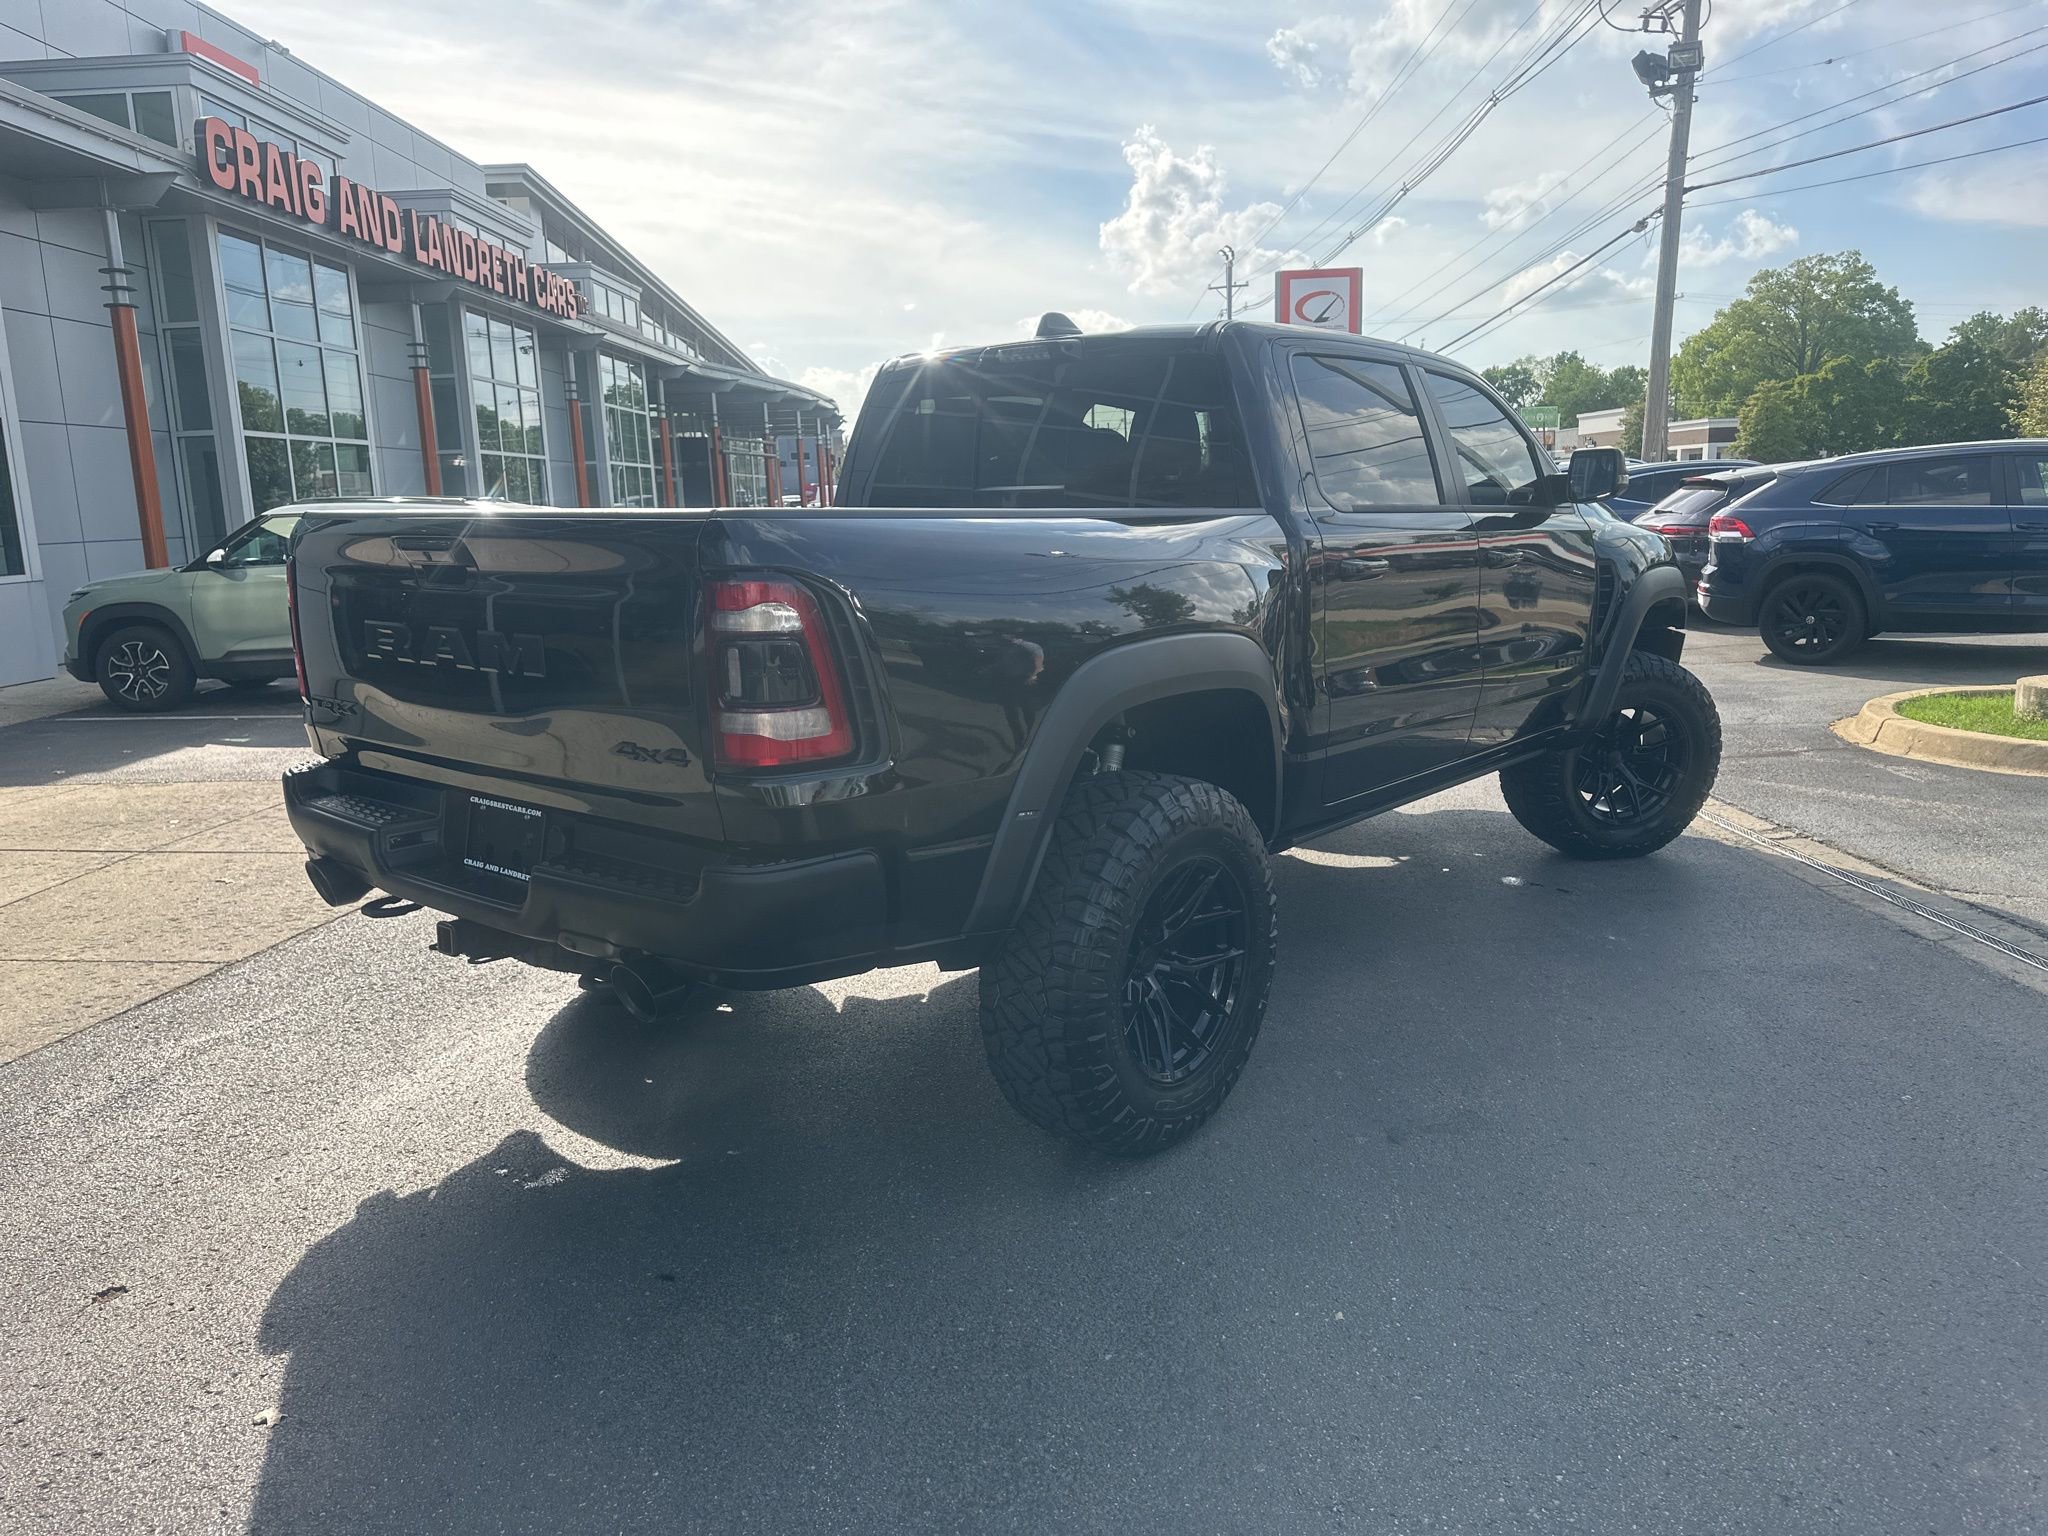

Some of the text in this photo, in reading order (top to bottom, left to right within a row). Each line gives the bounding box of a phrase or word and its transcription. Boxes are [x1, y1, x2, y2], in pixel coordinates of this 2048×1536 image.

[197, 115, 326, 225] CRAIG
[332, 176, 402, 254] AND
[406, 209, 528, 302] LANDRETH
[530, 264, 577, 320] CARS
[364, 619, 545, 678] RAM
[470, 796, 542, 817] CRAIGSBESTCARS.COM
[463, 858, 531, 881] CRAIG AND LANDRET
